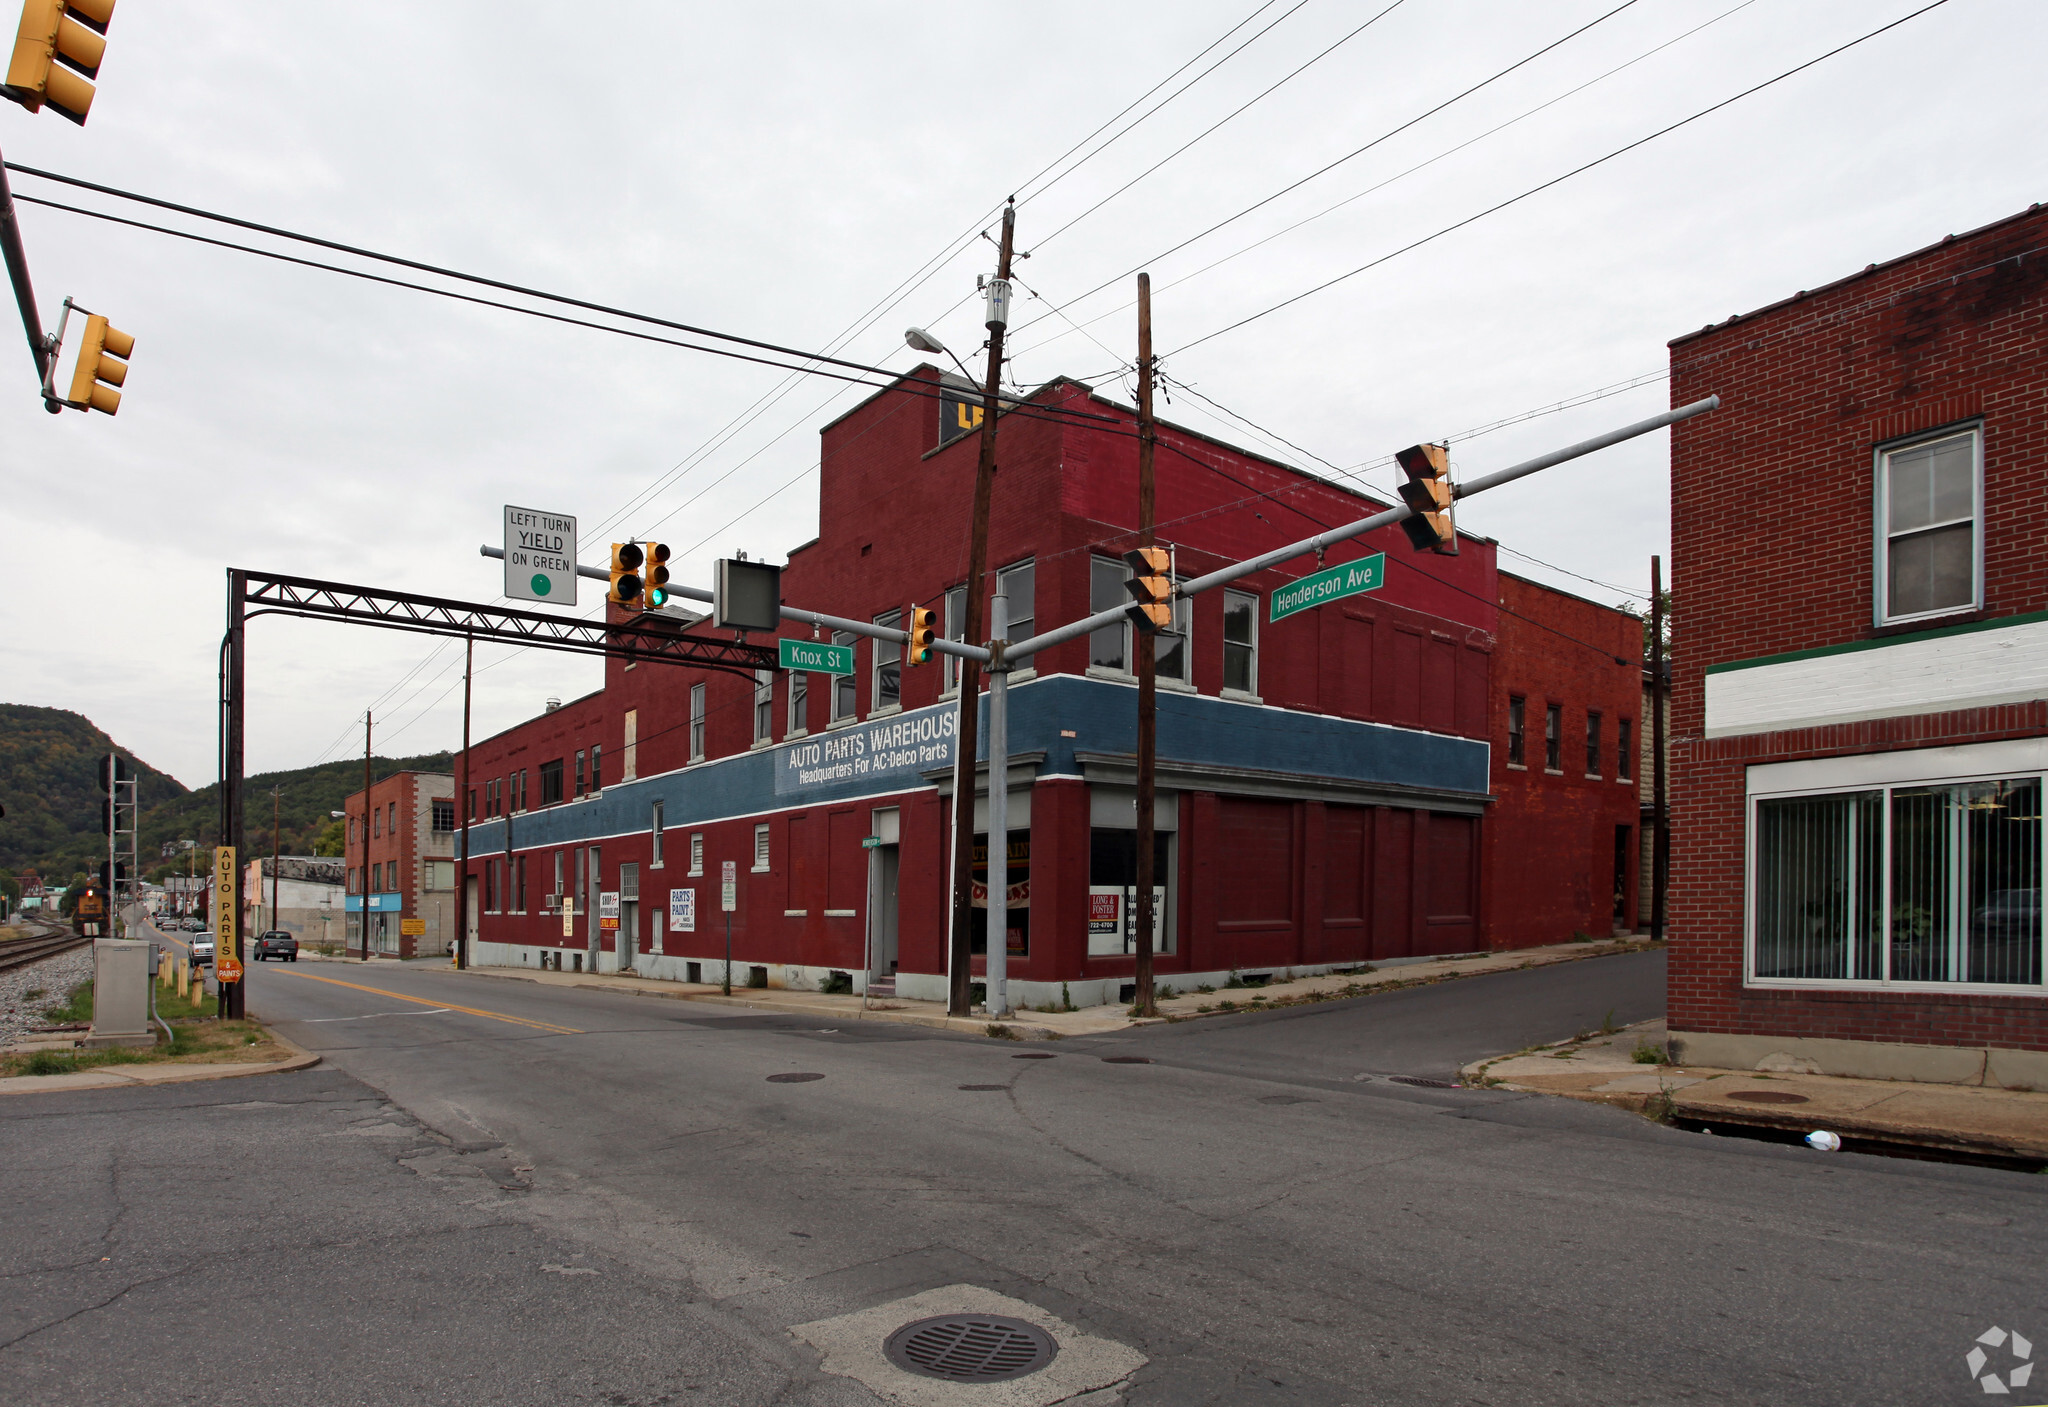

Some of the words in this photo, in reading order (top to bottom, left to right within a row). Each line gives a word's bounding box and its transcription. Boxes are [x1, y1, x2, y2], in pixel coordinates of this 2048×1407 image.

[510, 511, 537, 528] LEFT
[542, 516, 571, 534] TURN
[518, 530, 563, 551] YIELD
[512, 552, 527, 566] ON
[533, 555, 570, 572] GREEN
[1277, 576, 1341, 613] Henderson
[1346, 567, 1373, 589] Ave
[791, 646, 823, 666] Knox
[827, 650, 841, 668] St
[789, 745, 820, 769] AUTO
[825, 732, 865, 762] PARTS
[799, 761, 853, 785] Headquarters
[855, 757, 870, 775] For
[872, 749, 917, 773] AC-Delco
[919, 742, 948, 763] Parts
[221, 850, 231, 893] AUTO
[672, 891, 690, 902] PARTS
[1092, 895, 1108, 904] LONG
[1109, 895, 1115, 905] &
[672, 904, 689, 915] PAINT
[1092, 904, 1115, 914] FOSTER
[221, 902, 231, 955] PARTS
[218, 969, 241, 978] PAINTS
[225, 961, 231, 969] &
